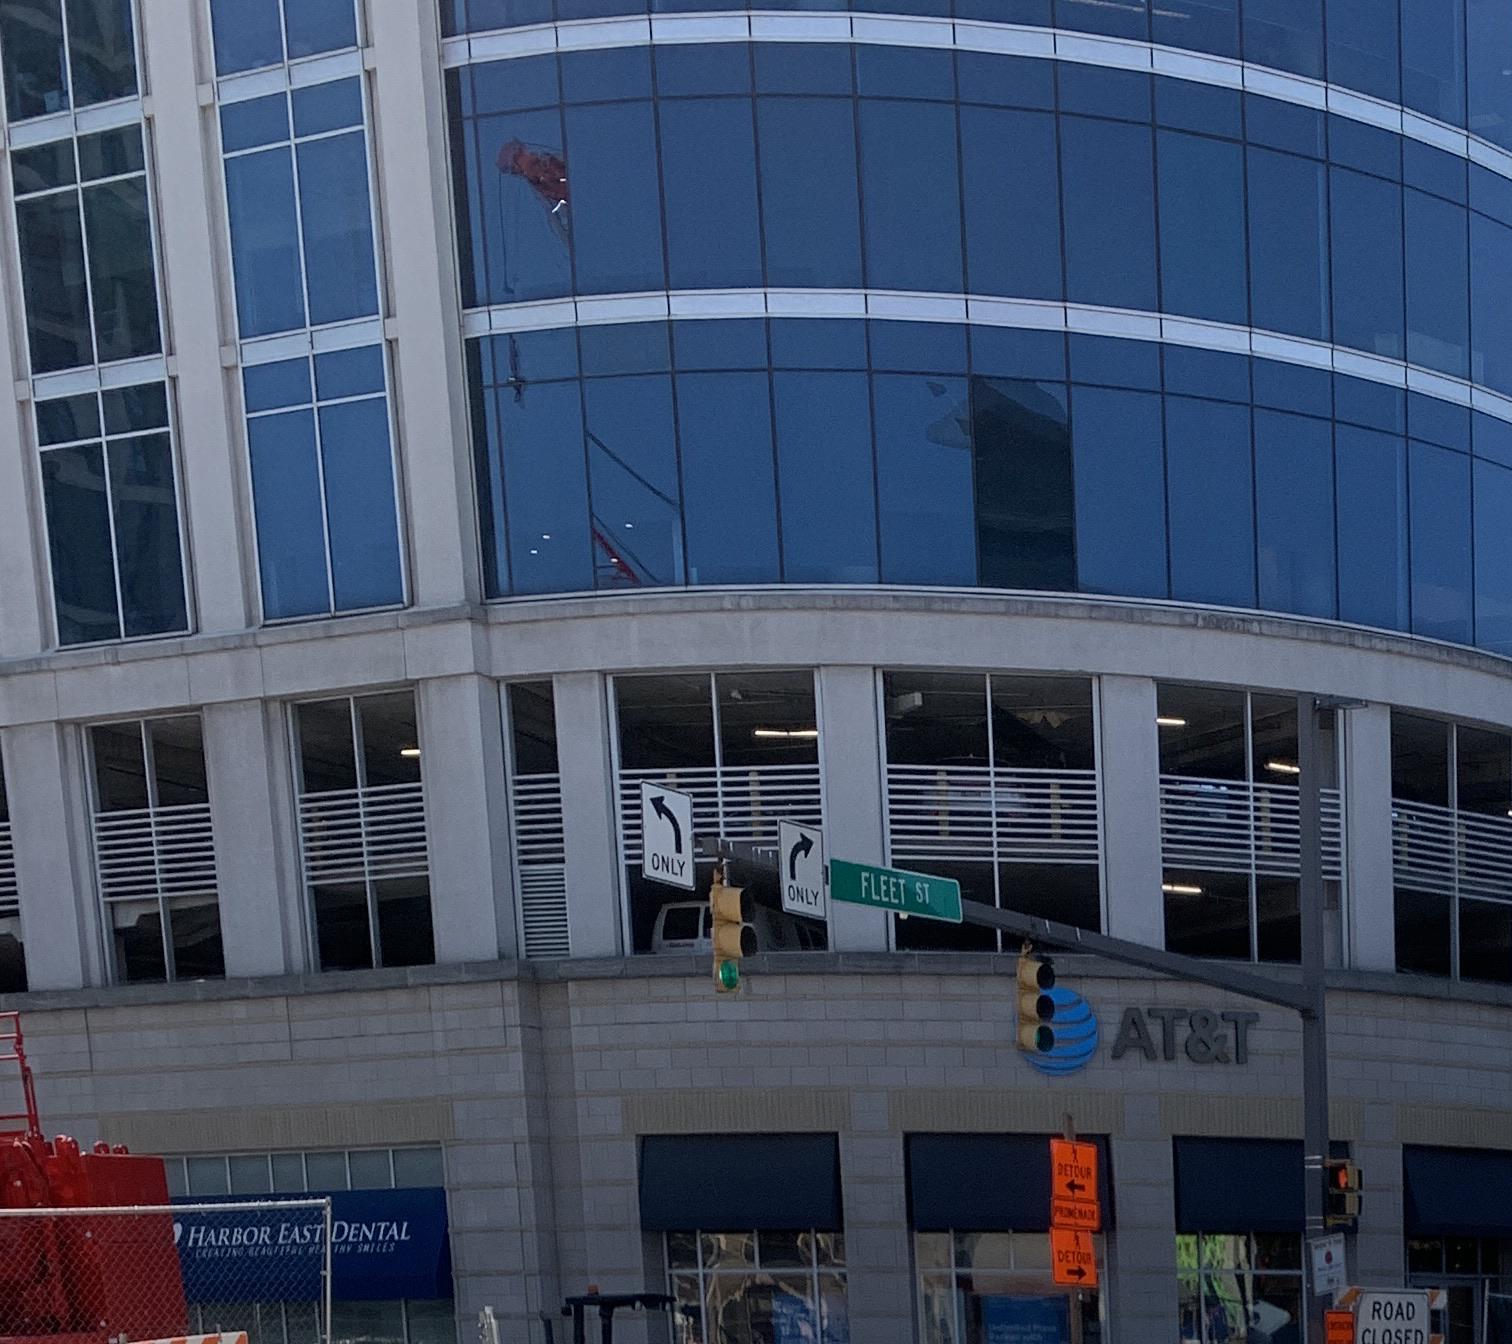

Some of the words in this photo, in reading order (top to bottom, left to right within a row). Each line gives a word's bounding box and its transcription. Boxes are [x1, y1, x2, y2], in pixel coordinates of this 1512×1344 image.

[651, 852, 686, 878] ONLY
[787, 883, 820, 908] ONLY
[860, 871, 906, 903] FLEET
[915, 880, 931, 905] ST
[1111, 1007, 1260, 1065] AT&T
[1058, 1163, 1092, 1179] DETOUR
[188, 1226, 271, 1247] HARBOR
[278, 1222, 325, 1244] EAST
[331, 1221, 411, 1243] DENTAL
[1057, 1250, 1092, 1265] DETOUR
[1372, 1301, 1416, 1320] ROAD
